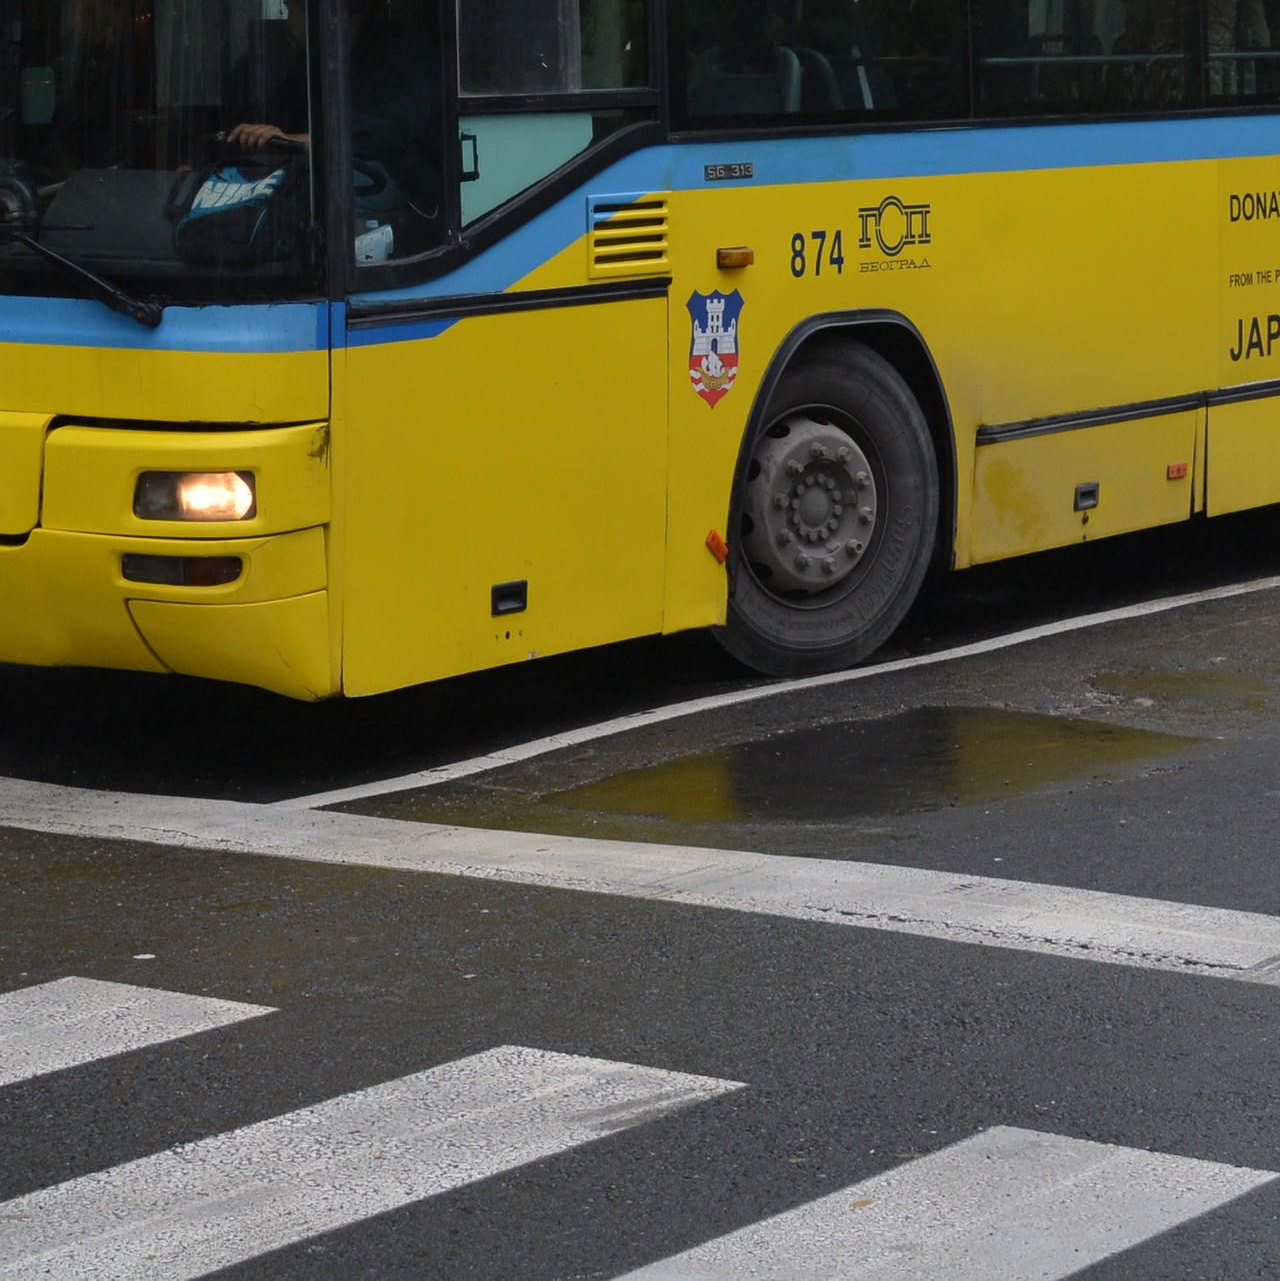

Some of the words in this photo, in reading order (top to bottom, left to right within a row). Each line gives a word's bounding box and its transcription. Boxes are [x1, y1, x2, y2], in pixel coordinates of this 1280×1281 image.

[191, 168, 285, 210] NIKE
[707, 165, 725, 179] SG
[731, 163, 754, 177] 313
[858, 195, 931, 257] ГСП
[790, 229, 845, 279] 874
[1229, 272, 1254, 288] FROM
[1256, 270, 1272, 284] THE
